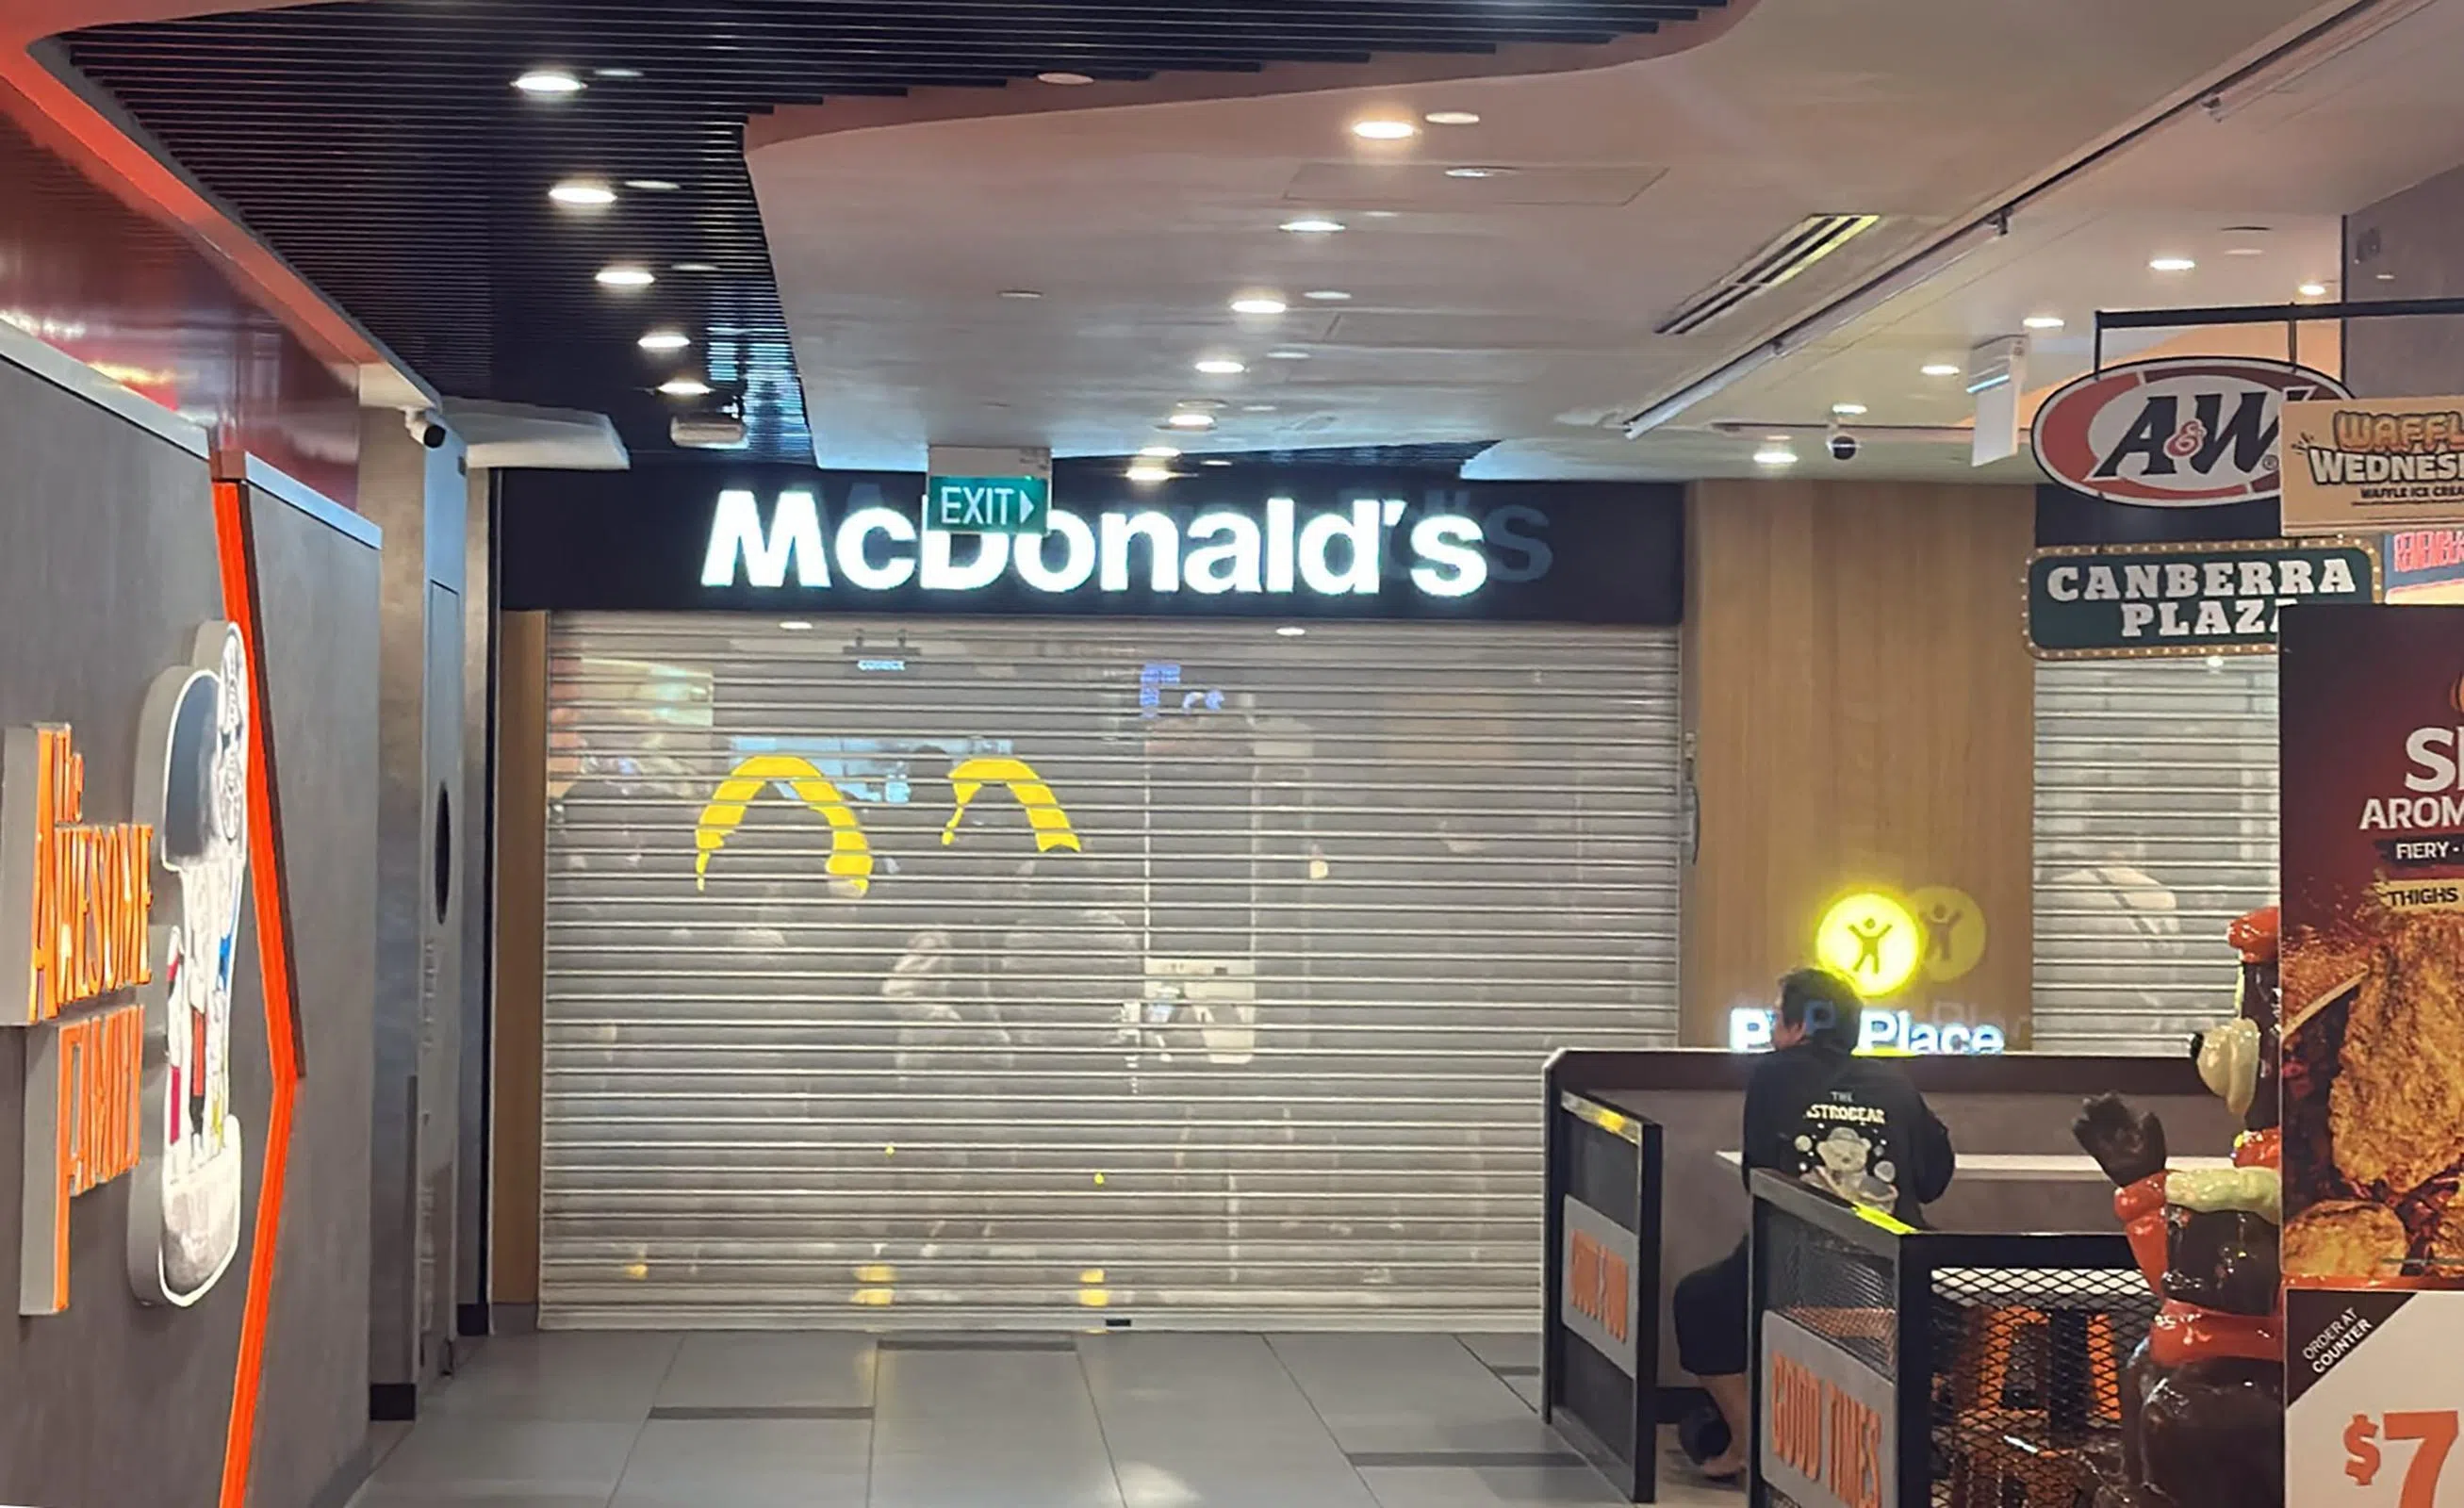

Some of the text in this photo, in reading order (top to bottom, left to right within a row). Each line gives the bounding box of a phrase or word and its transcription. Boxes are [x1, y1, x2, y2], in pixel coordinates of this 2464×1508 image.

[2092, 387, 2315, 479] A&W
[2308, 446, 2464, 484] WEDNES
[941, 485, 1015, 526] EXIT
[700, 489, 1488, 597] McDonald's
[2046, 558, 2357, 601] CANBERRA
[2405, 726, 2464, 794] S
[2395, 841, 2450, 860] FIERY
[28, 729, 154, 1024] AWESOME
[2387, 886, 2459, 907] THIGHS
[1857, 1009, 2006, 1053] Place
[2302, 1317, 2345, 1361] ORDER
[2311, 1318, 2373, 1374] COUNTER
